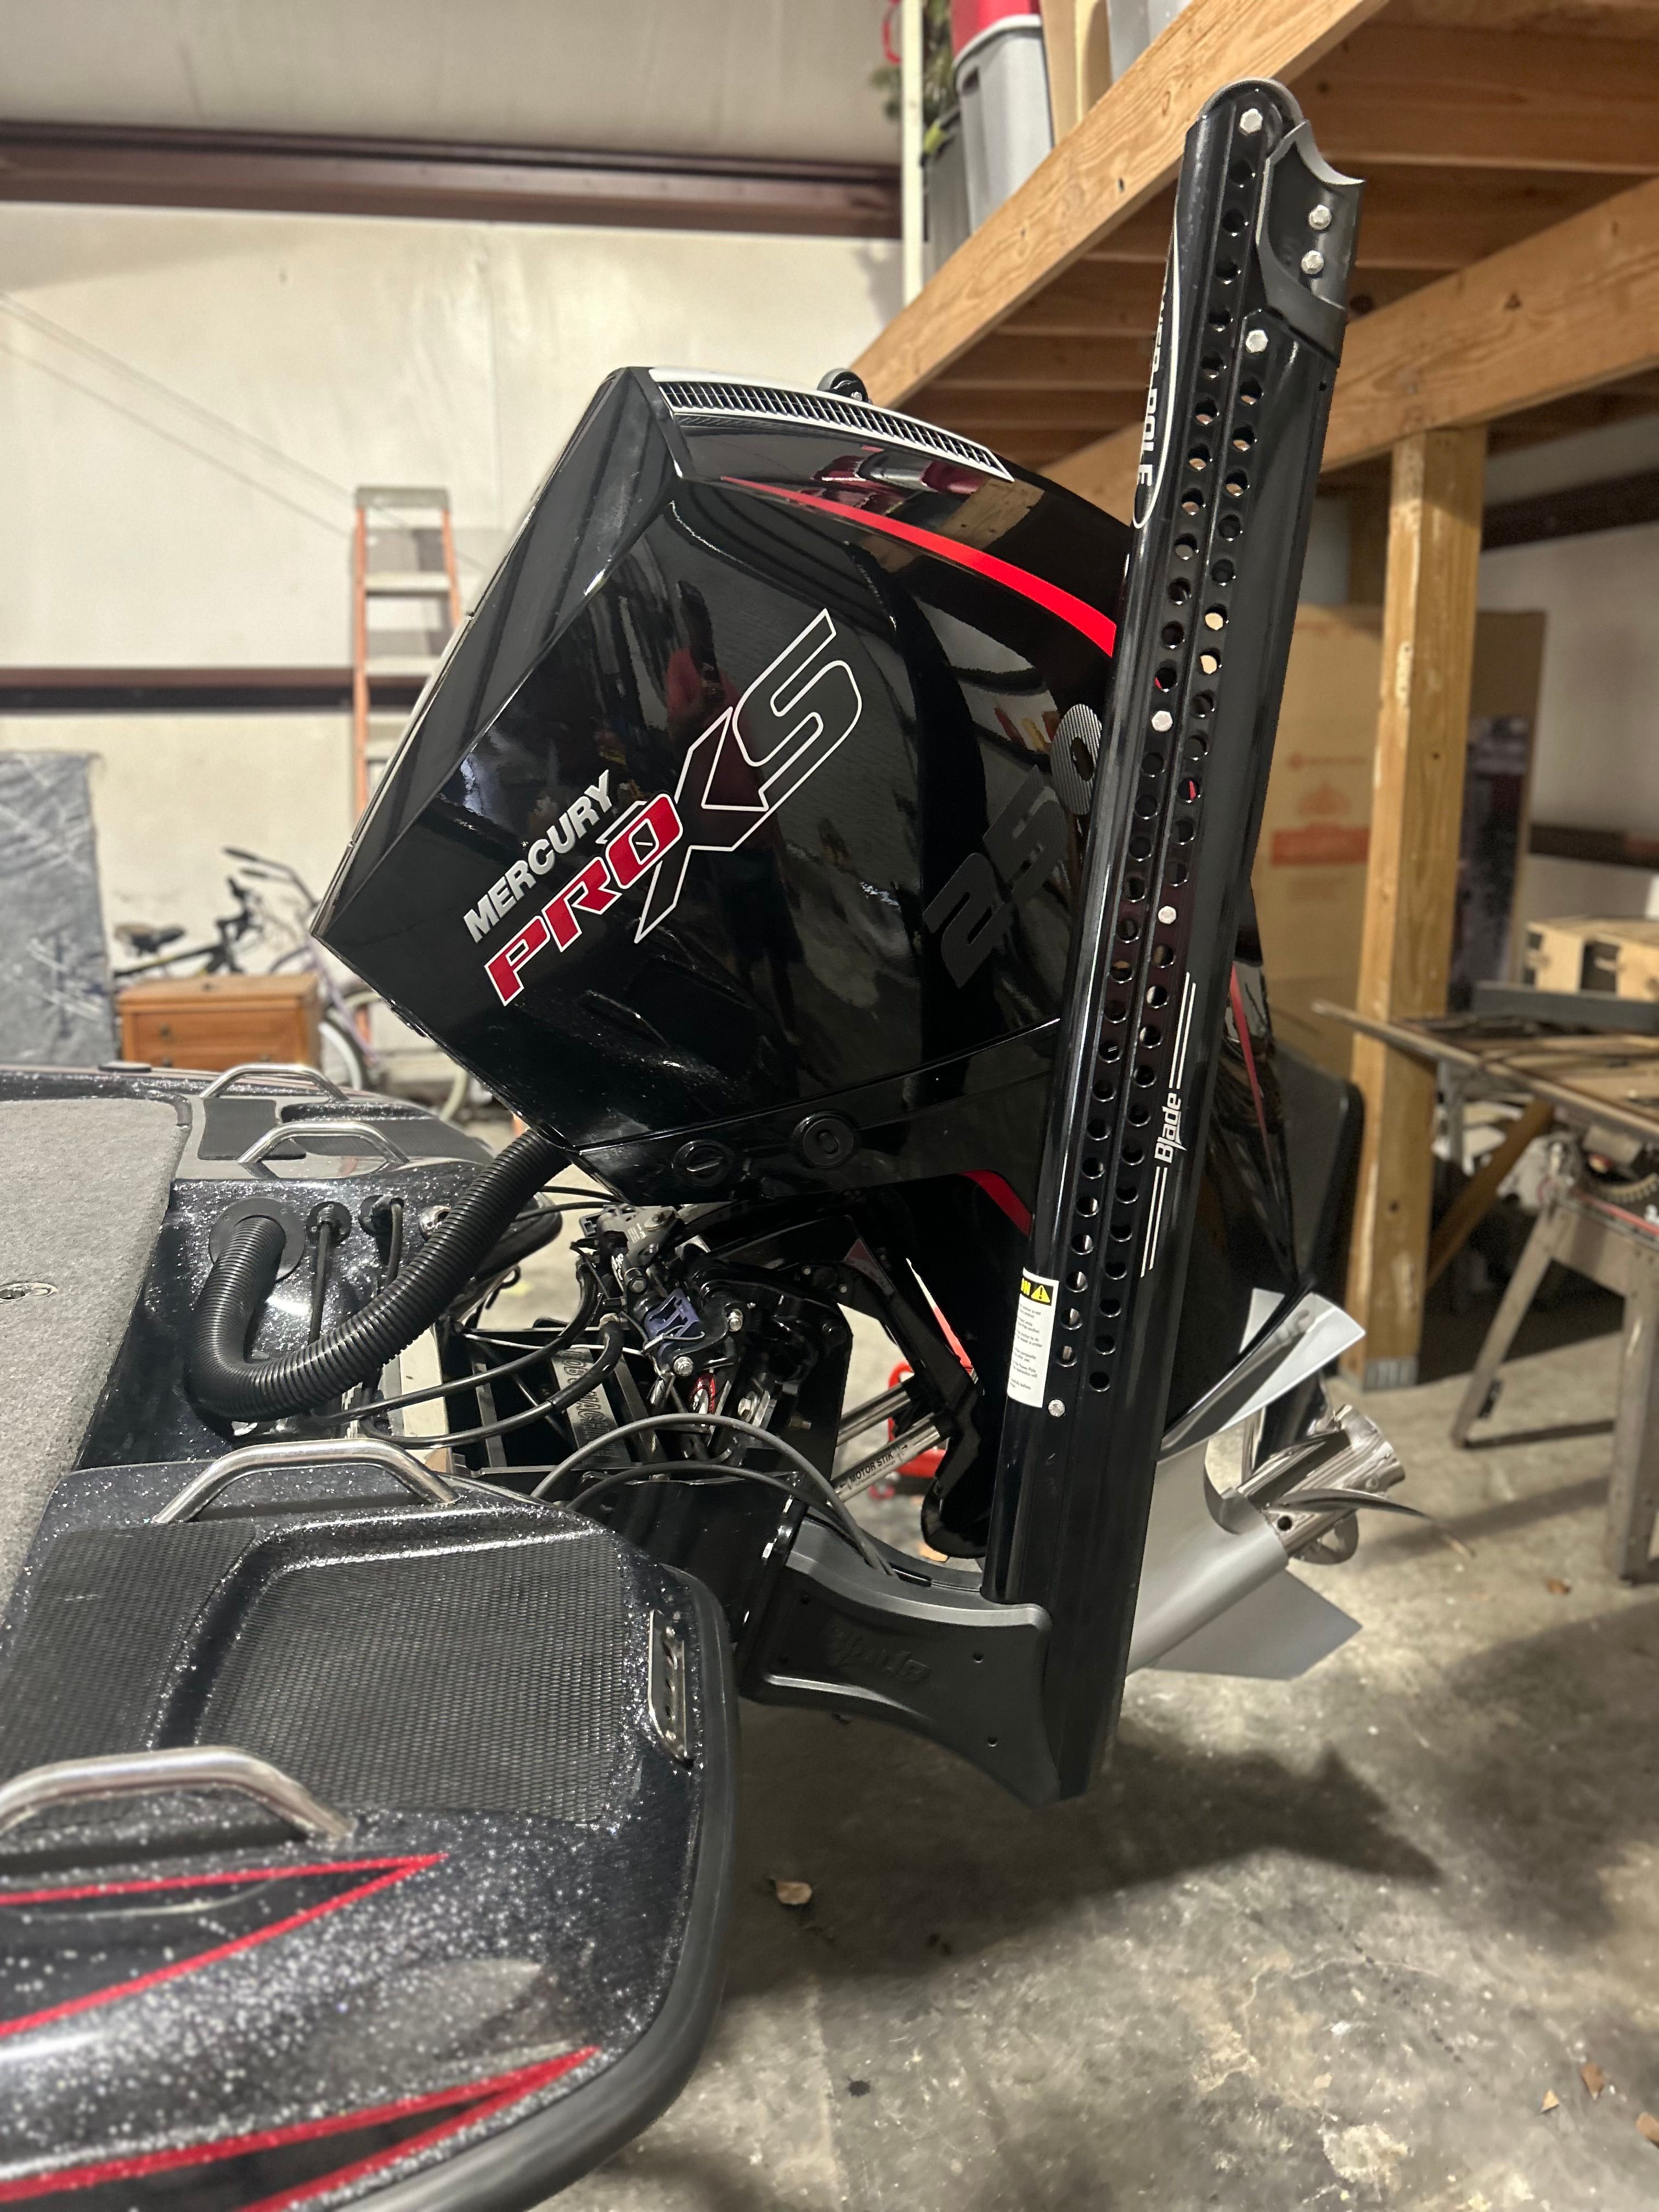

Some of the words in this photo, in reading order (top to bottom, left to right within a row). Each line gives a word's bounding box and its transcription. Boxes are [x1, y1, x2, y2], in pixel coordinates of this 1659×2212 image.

[463, 770, 610, 943] MERCURY
[483, 793, 684, 1007] PRO
[596, 608, 862, 944] XS
[1154, 1092, 1187, 1163] Blade
[850, 1462, 876, 1485] MOTOR
[877, 1451, 894, 1467] STIK
